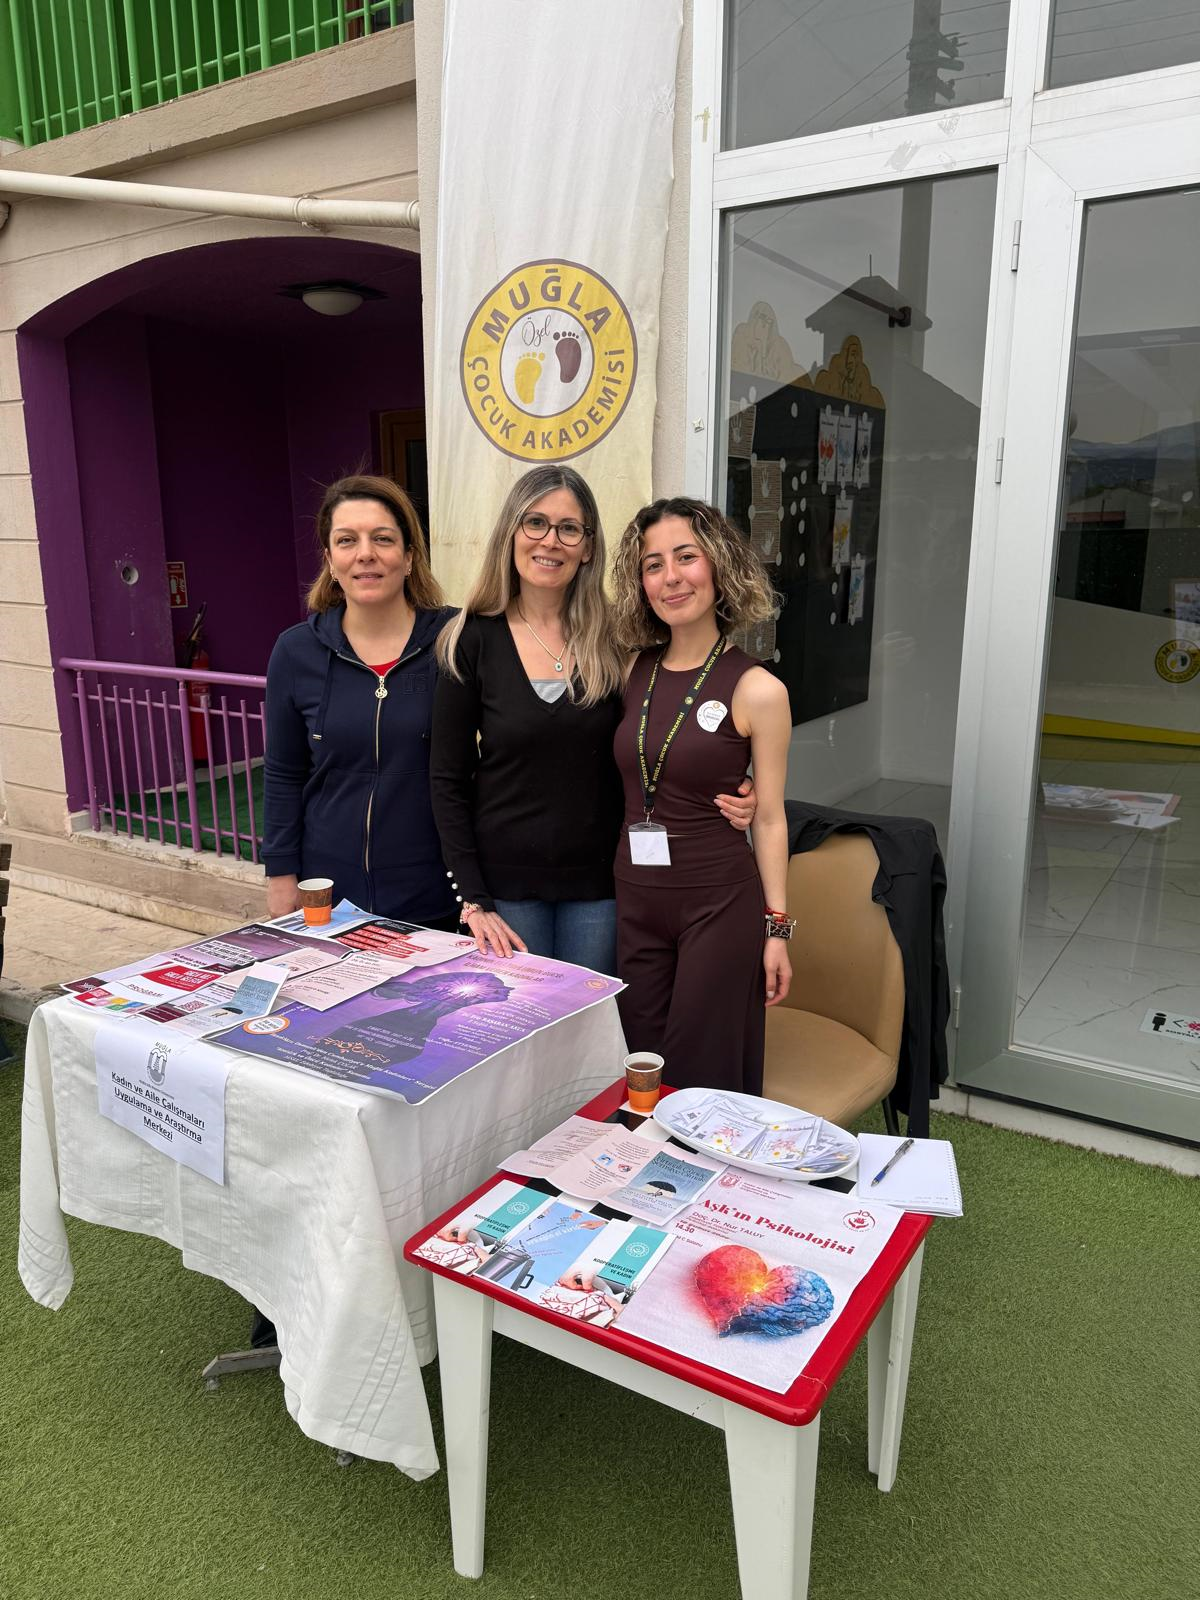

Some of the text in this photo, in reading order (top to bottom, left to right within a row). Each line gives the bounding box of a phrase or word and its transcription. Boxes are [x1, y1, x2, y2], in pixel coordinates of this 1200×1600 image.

[482, 268, 612, 344] MUĞLA
[521, 314, 552, 347] Özel
[467, 348, 625, 449] ÇOCUK AKADEMİSİ
[111, 1071, 133, 1089] Kadın
[134, 1084, 143, 1095] ve
[145, 1089, 160, 1104] Aile
[161, 1098, 205, 1128] Çalışmaları
[114, 1086, 152, 1114] Uygulama
[154, 1108, 163, 1118] ve
[165, 1114, 202, 1142] Araştırma
[143, 1115, 173, 1140] Merkezi
[675, 1222, 695, 1233] 14.30
[723, 1222, 738, 1230] Nur
[755, 1216, 856, 1255] Psikolojisi
